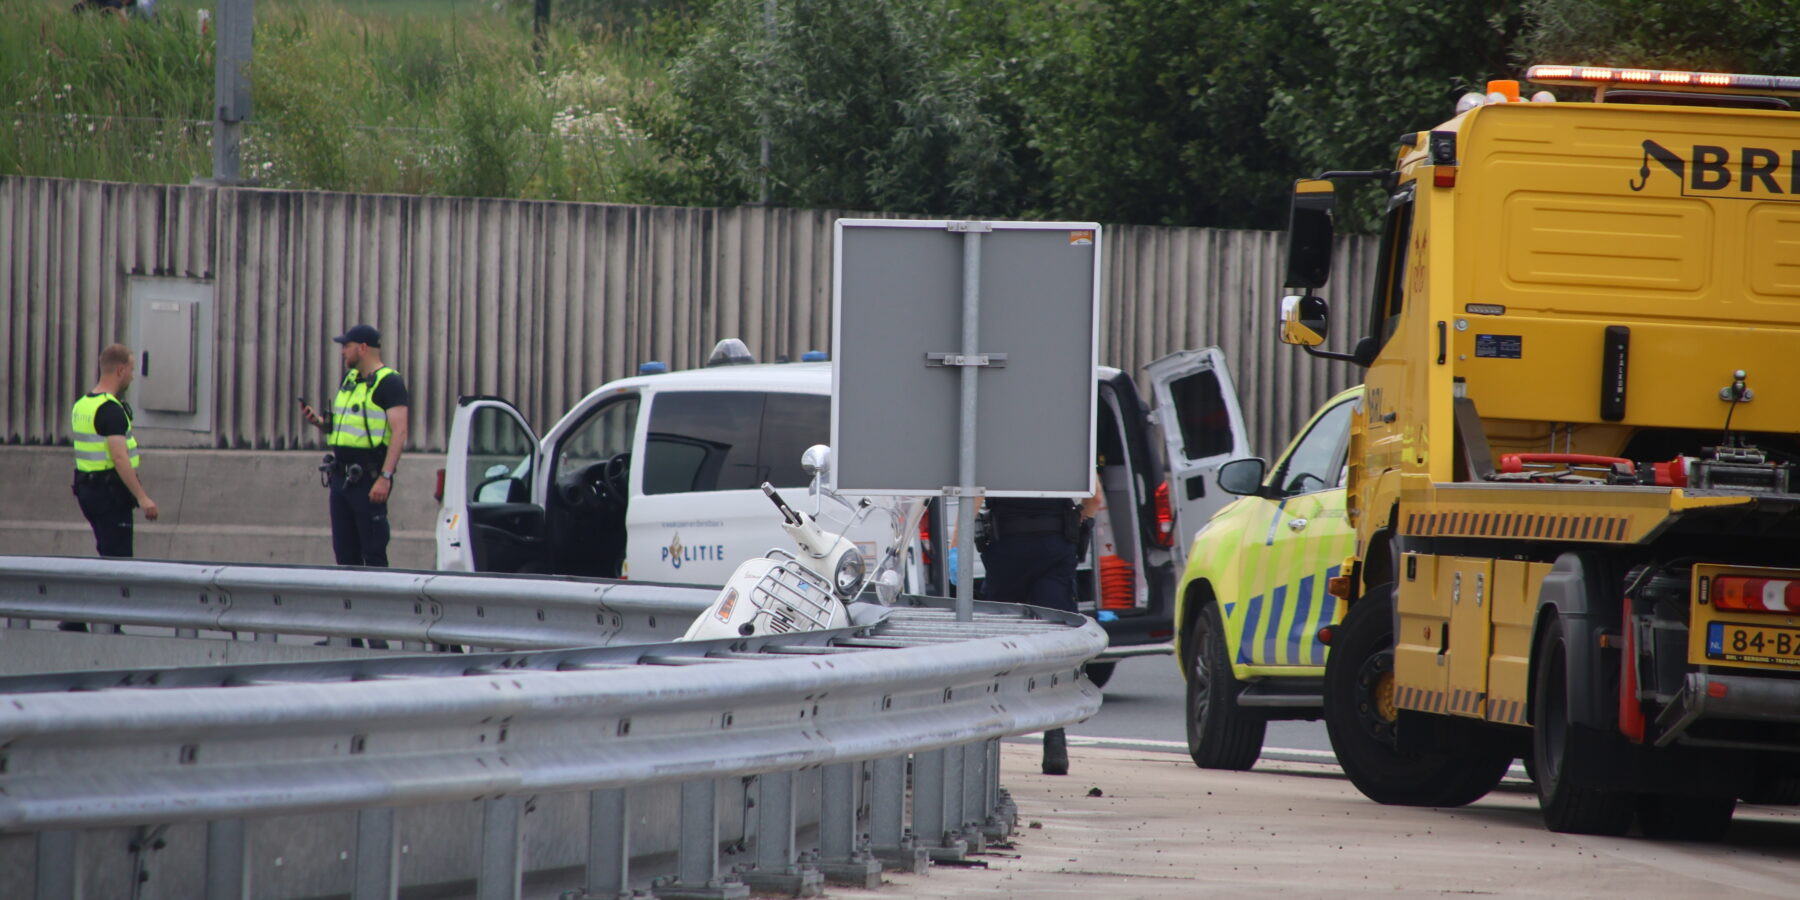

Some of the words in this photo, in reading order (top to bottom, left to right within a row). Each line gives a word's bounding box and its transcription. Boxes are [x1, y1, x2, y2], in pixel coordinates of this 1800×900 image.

[1691, 145, 1800, 194] BR
[661, 545, 724, 569] POLITIE
[1710, 641, 1721, 650] NL
